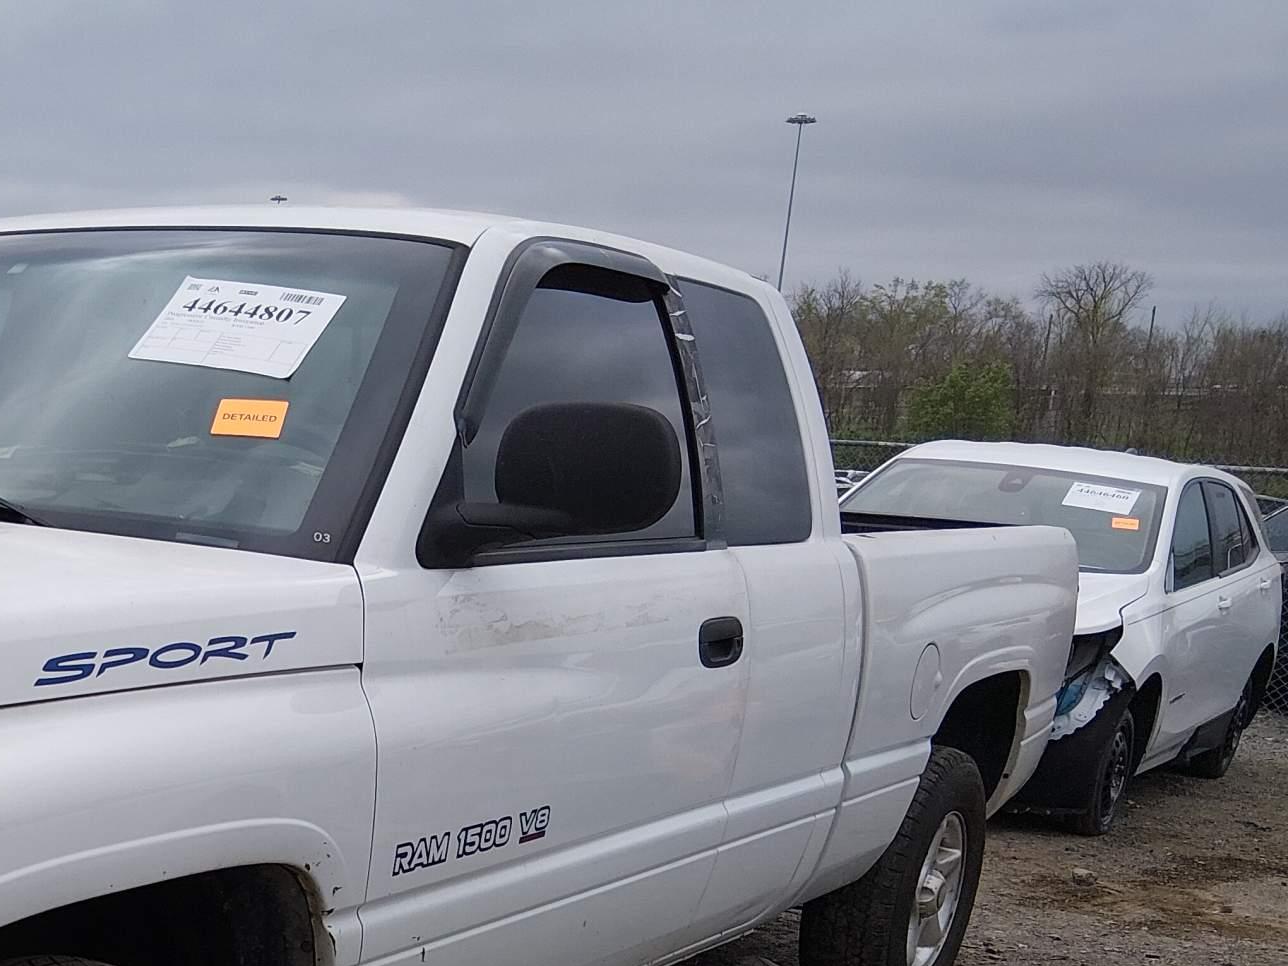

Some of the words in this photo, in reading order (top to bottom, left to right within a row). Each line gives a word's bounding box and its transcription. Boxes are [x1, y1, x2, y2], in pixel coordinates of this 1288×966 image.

[182, 297, 312, 325] 44644807
[222, 412, 278, 423] DETAILED
[313, 532, 331, 543] 03
[34, 631, 297, 687] SPORT
[392, 832, 451, 876] RAM
[456, 816, 513, 858] 1500
[519, 805, 551, 836] V8
